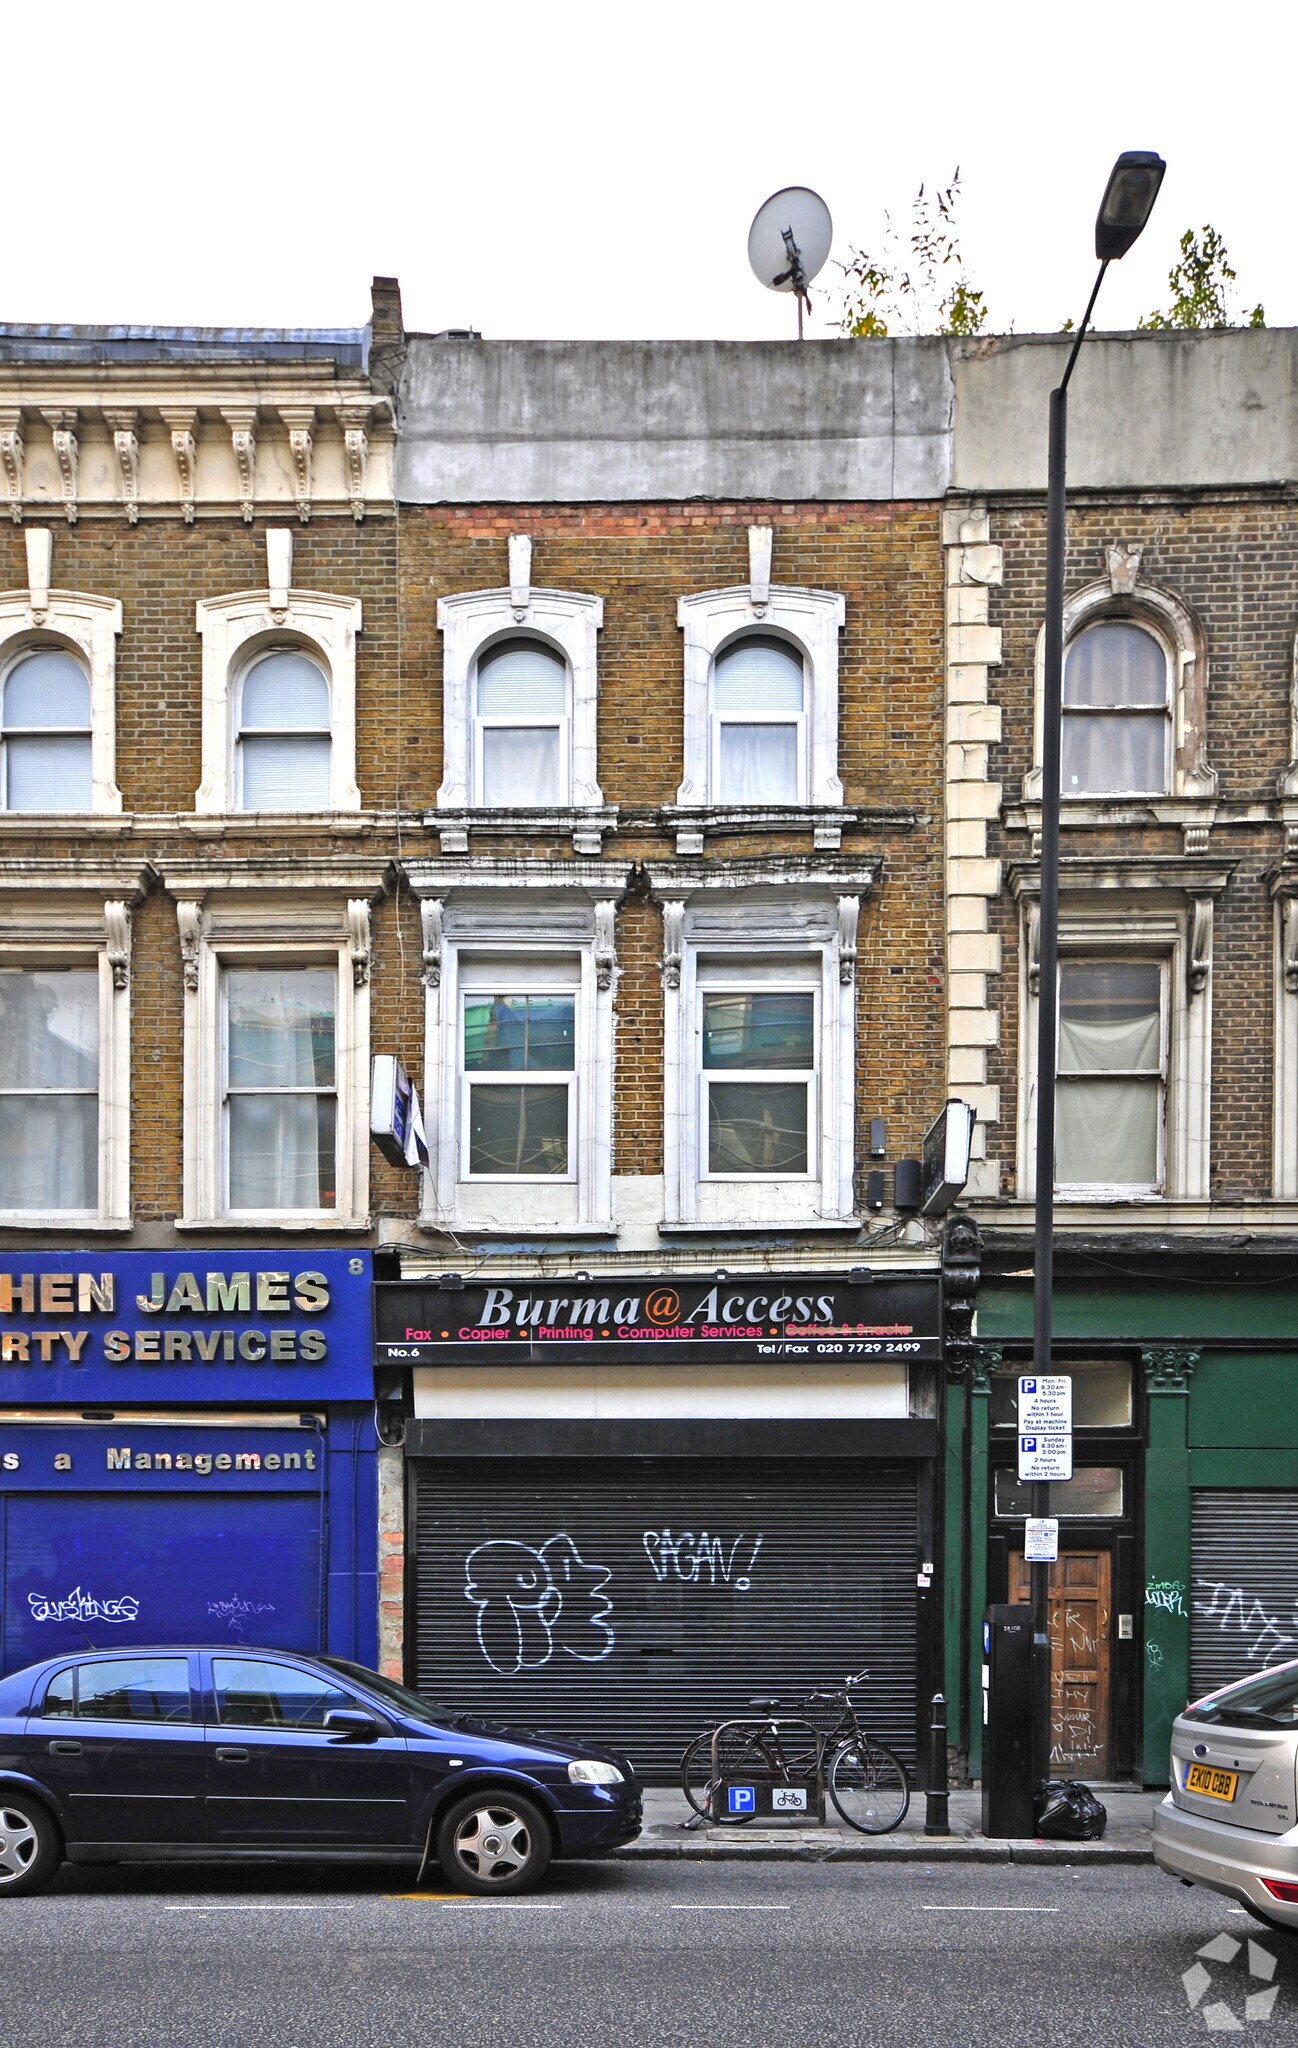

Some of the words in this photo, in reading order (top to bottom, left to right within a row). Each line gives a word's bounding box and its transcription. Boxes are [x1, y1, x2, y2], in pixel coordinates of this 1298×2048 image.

[349, 1258, 364, 1276] 8
[136, 1270, 331, 1313] JAMES
[405, 1327, 432, 1341] Fax
[458, 1326, 511, 1342] Copier
[538, 1325, 594, 1342] Printing
[617, 1324, 695, 1341] Computer
[700, 1324, 763, 1339] Services
[104, 1329, 328, 1362] SERVICES
[387, 1347, 420, 1358] No.6
[816, 1343, 843, 1354] 020
[847, 1342, 882, 1353] 7729
[885, 1342, 921, 1353] 2499
[54, 1451, 73, 1471] a
[106, 1447, 317, 1475] Management
[1190, 1767, 1212, 1790] EK10
[1211, 1773, 1232, 1796] CBB
[734, 1789, 751, 1810] P
